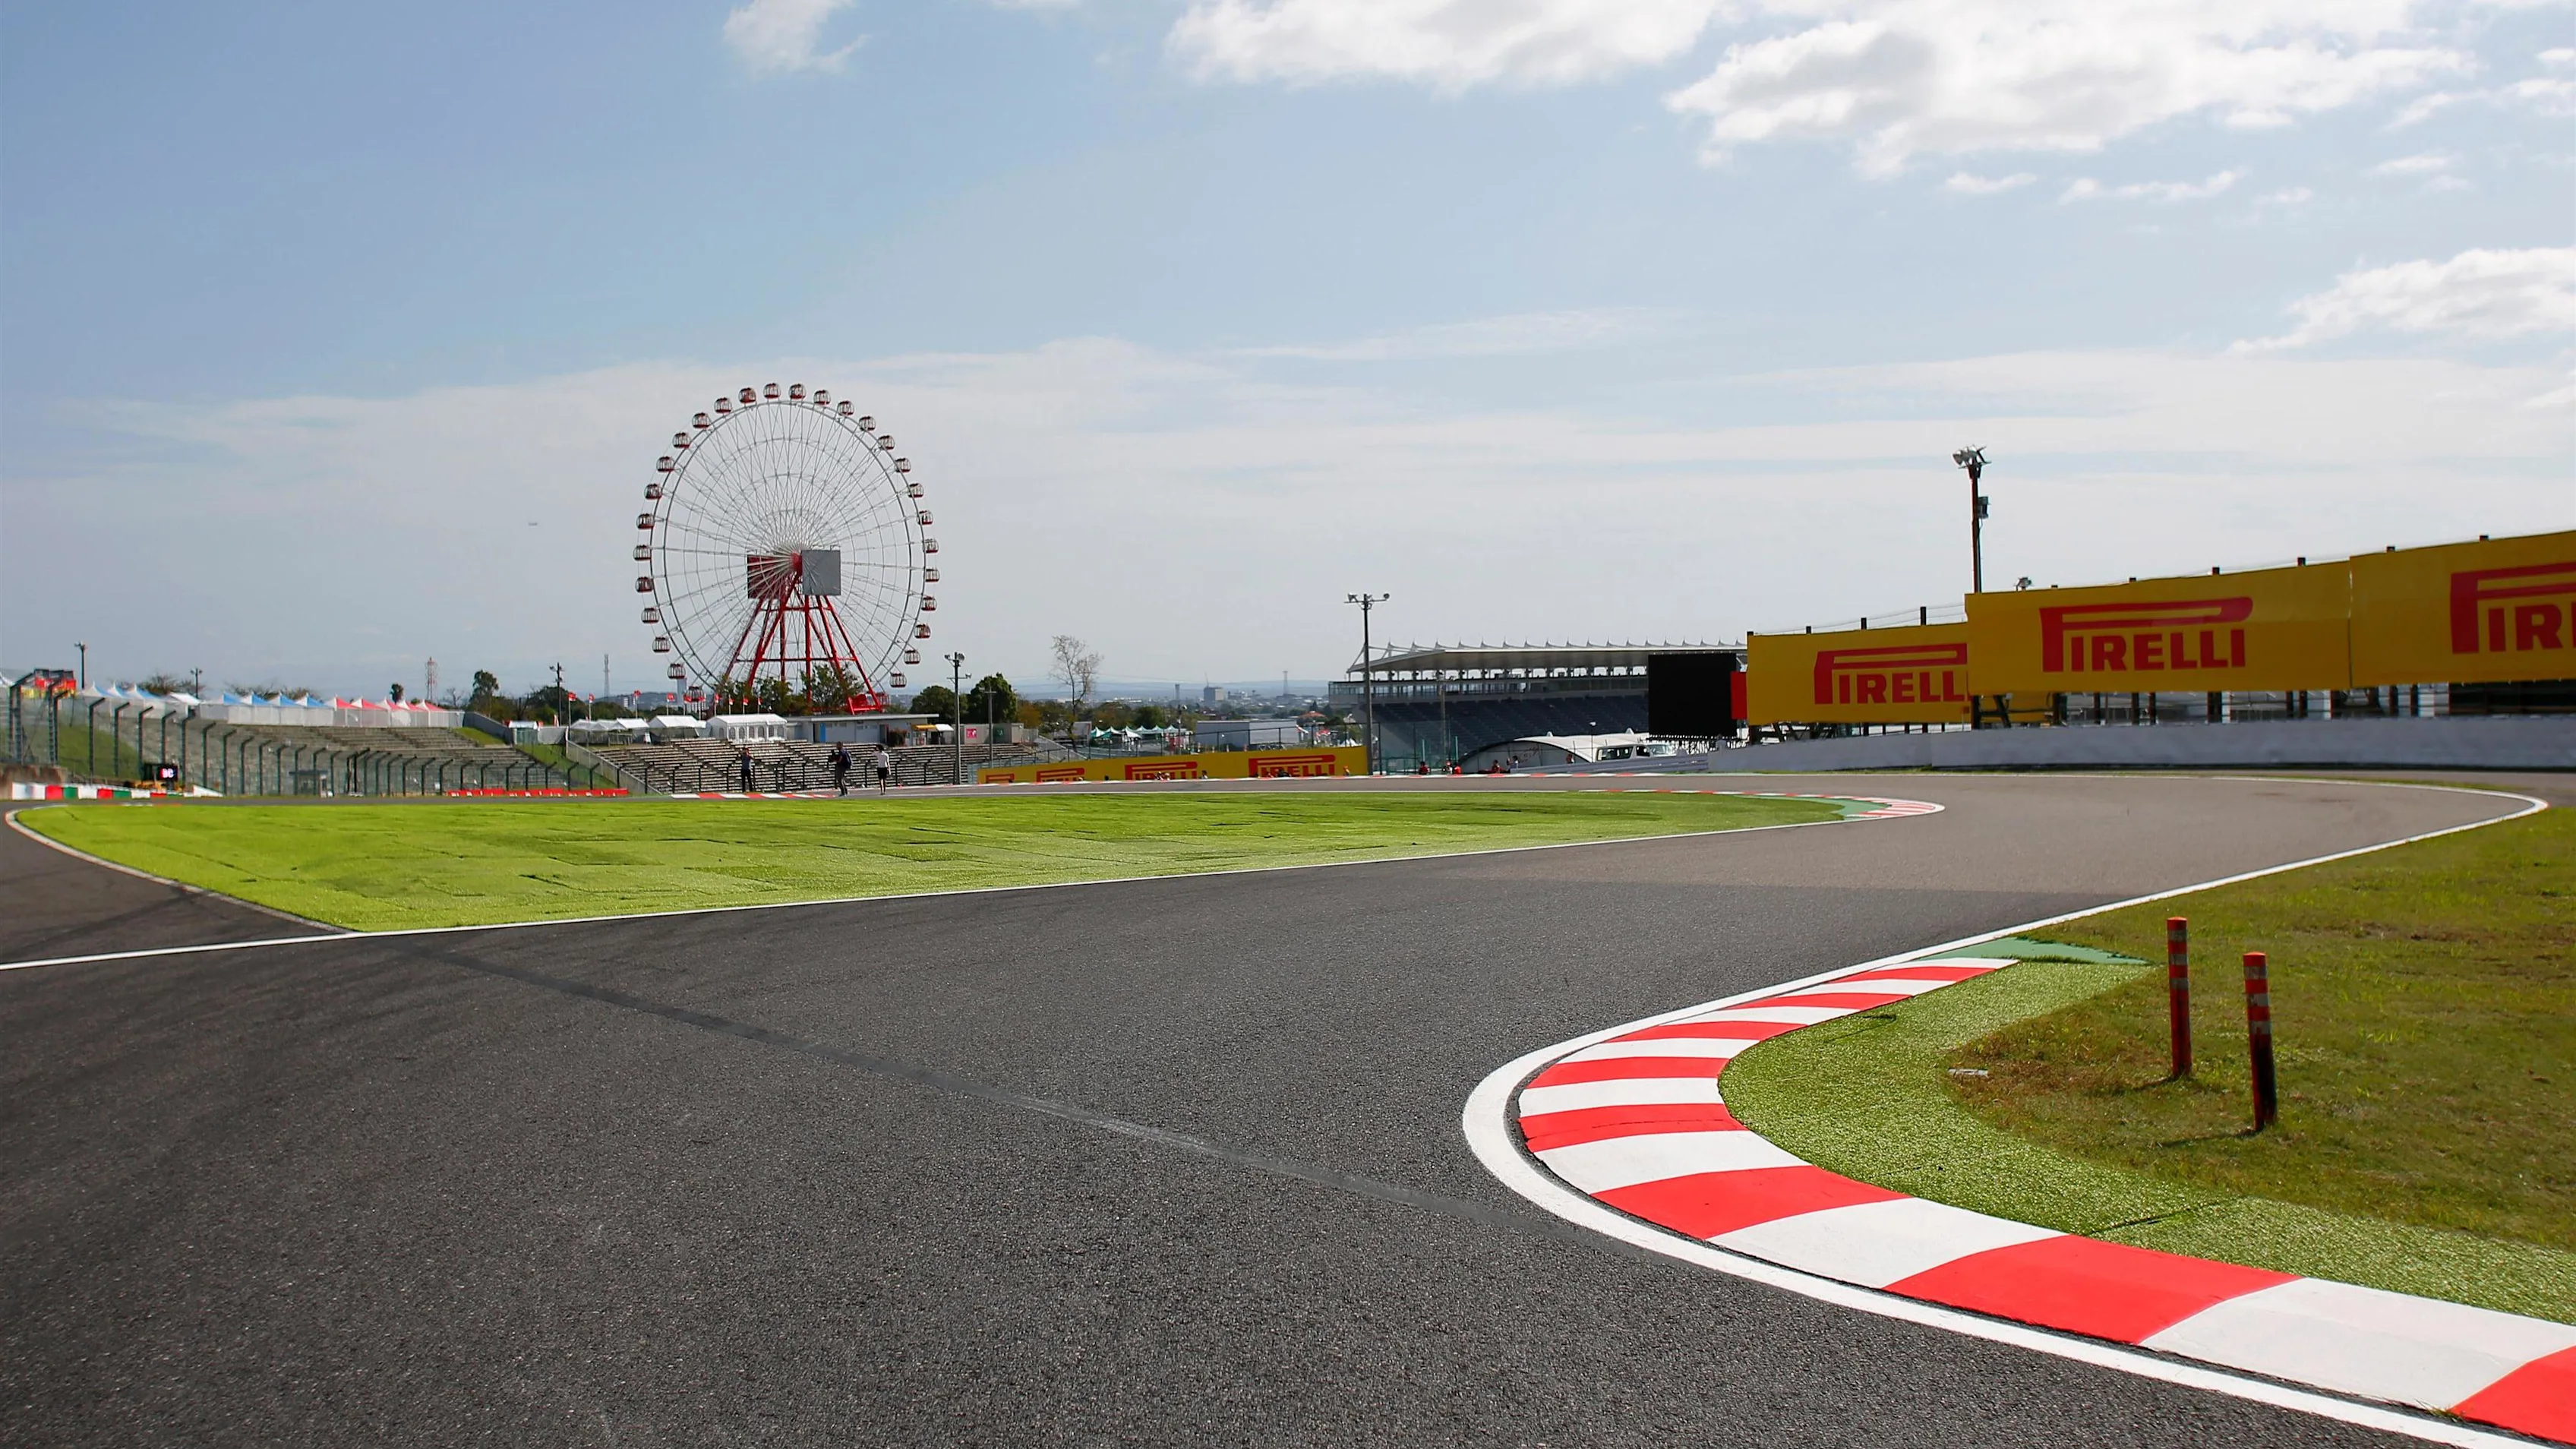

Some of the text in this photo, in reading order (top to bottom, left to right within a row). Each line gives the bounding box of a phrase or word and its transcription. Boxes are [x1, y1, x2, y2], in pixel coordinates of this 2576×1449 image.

[2039, 596, 2253, 672] PIRELLI
[2450, 561, 2576, 655] PIR
[1814, 643, 1972, 705] PIRELL
